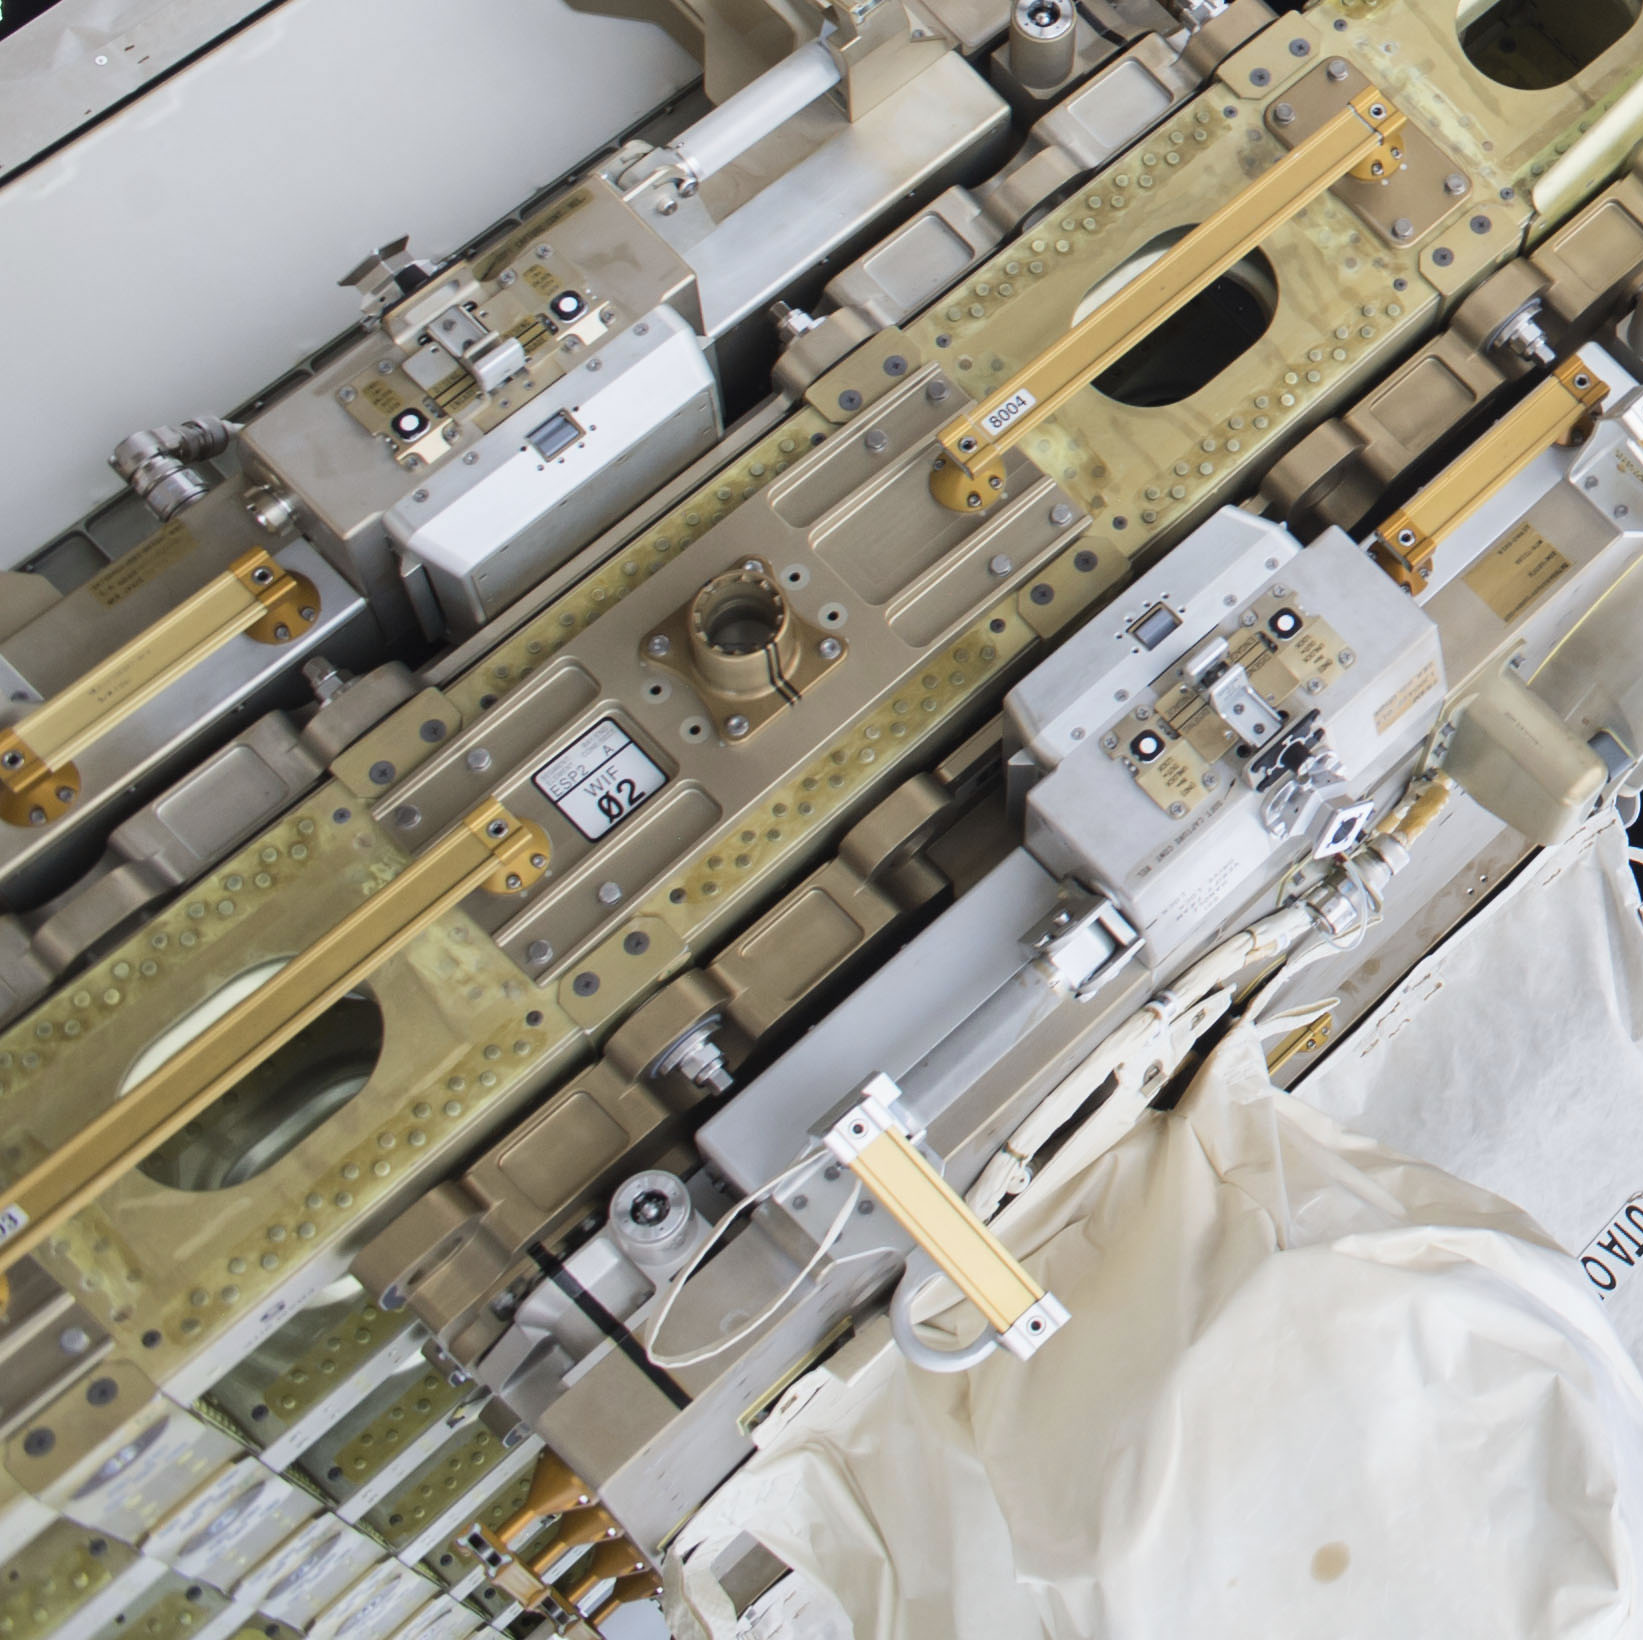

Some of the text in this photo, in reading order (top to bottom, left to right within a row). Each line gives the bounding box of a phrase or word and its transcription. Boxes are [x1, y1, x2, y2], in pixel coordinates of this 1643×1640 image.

[989, 396, 1027, 428] 8004
[549, 764, 590, 798] ESP2
[602, 744, 615, 757] A
[583, 765, 618, 797] WIF
